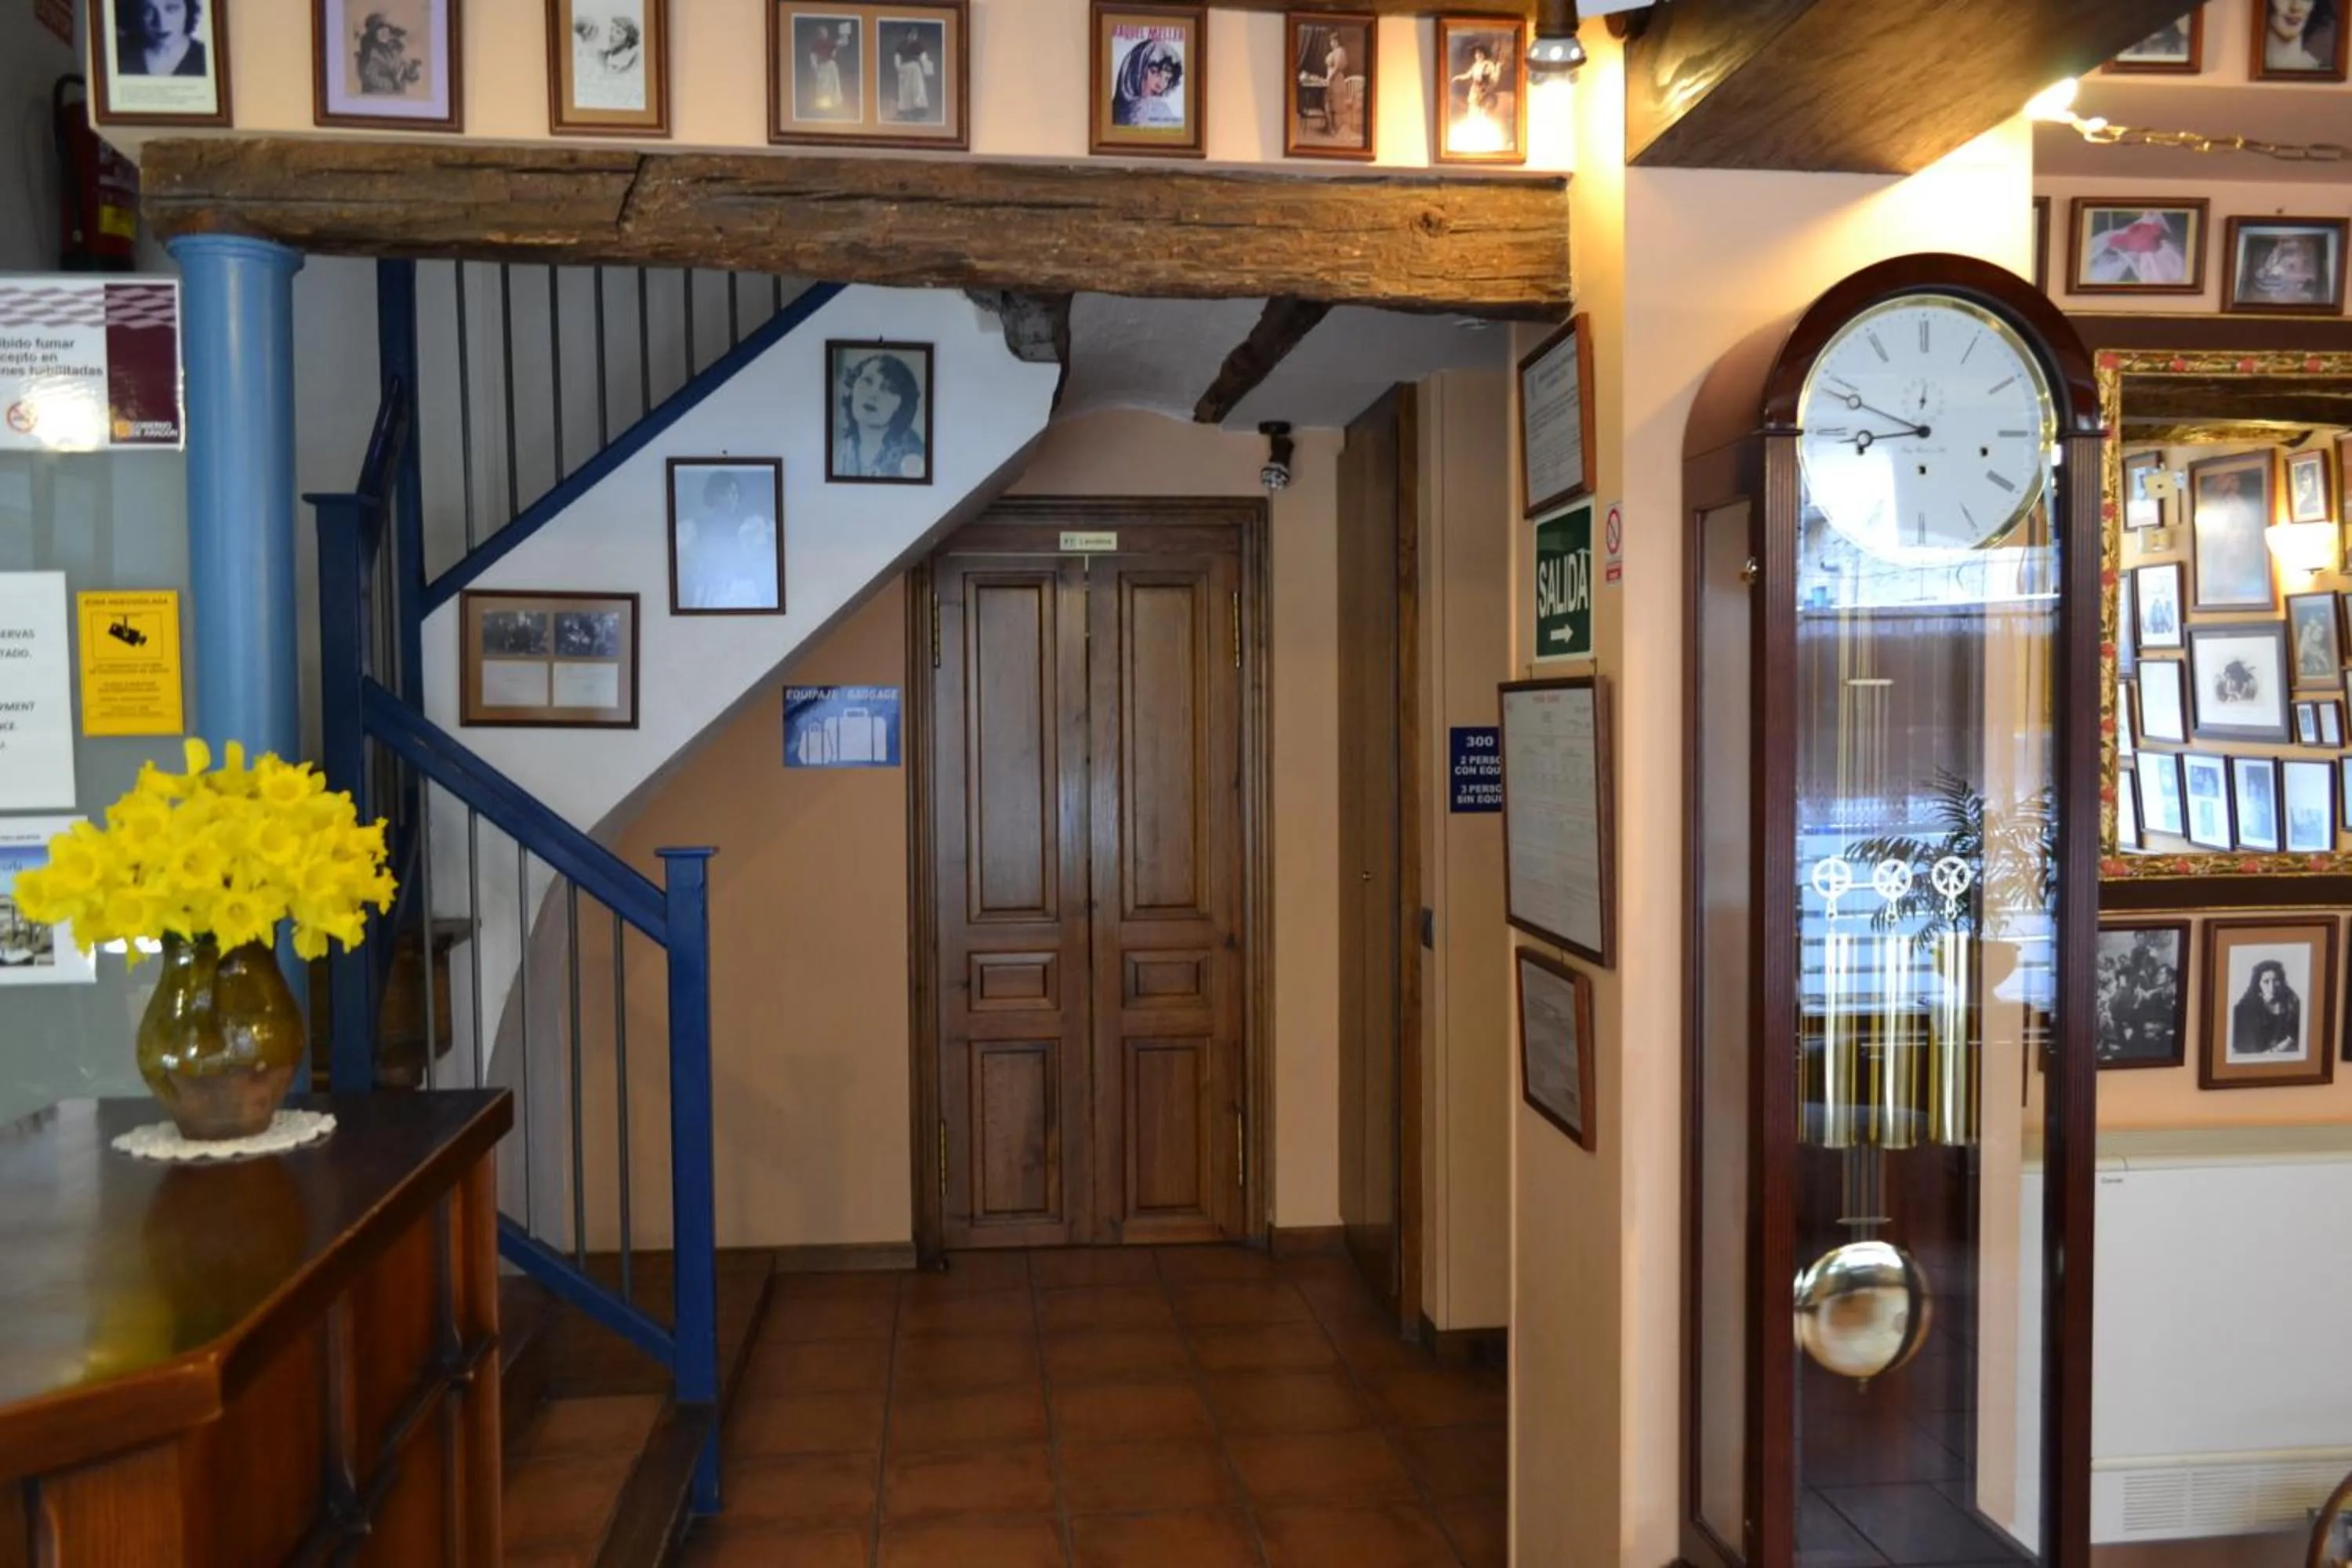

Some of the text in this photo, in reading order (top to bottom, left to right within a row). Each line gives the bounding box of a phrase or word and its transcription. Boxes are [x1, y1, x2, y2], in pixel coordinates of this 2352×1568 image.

[35, 337, 74, 349] fumar
[1538, 548, 1589, 619] SALIDA
[786, 689, 836, 702] EQUIPAJE
[1466, 736, 1494, 747] 300
[1454, 766, 1476, 775] CON
[1457, 795, 1475, 804] SIN
